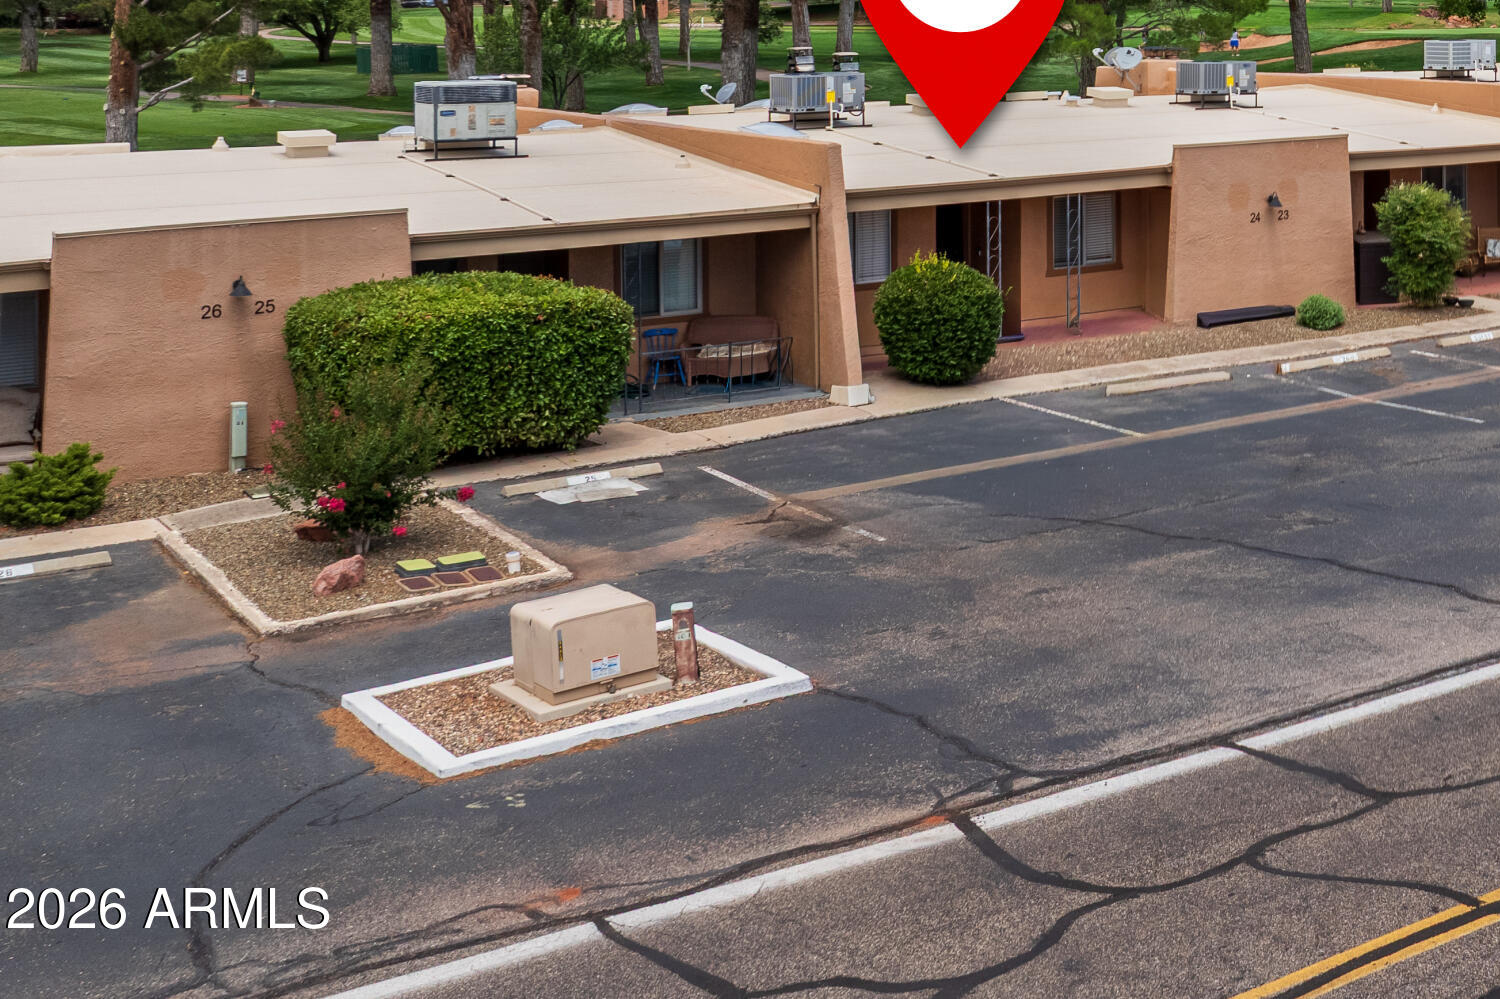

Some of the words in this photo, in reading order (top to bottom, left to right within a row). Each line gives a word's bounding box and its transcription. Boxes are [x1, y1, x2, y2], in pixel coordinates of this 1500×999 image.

[1250, 212, 1261, 223] 24
[1277, 209, 1289, 221] 23
[200, 304, 222, 319] 26
[254, 299, 276, 315] 25
